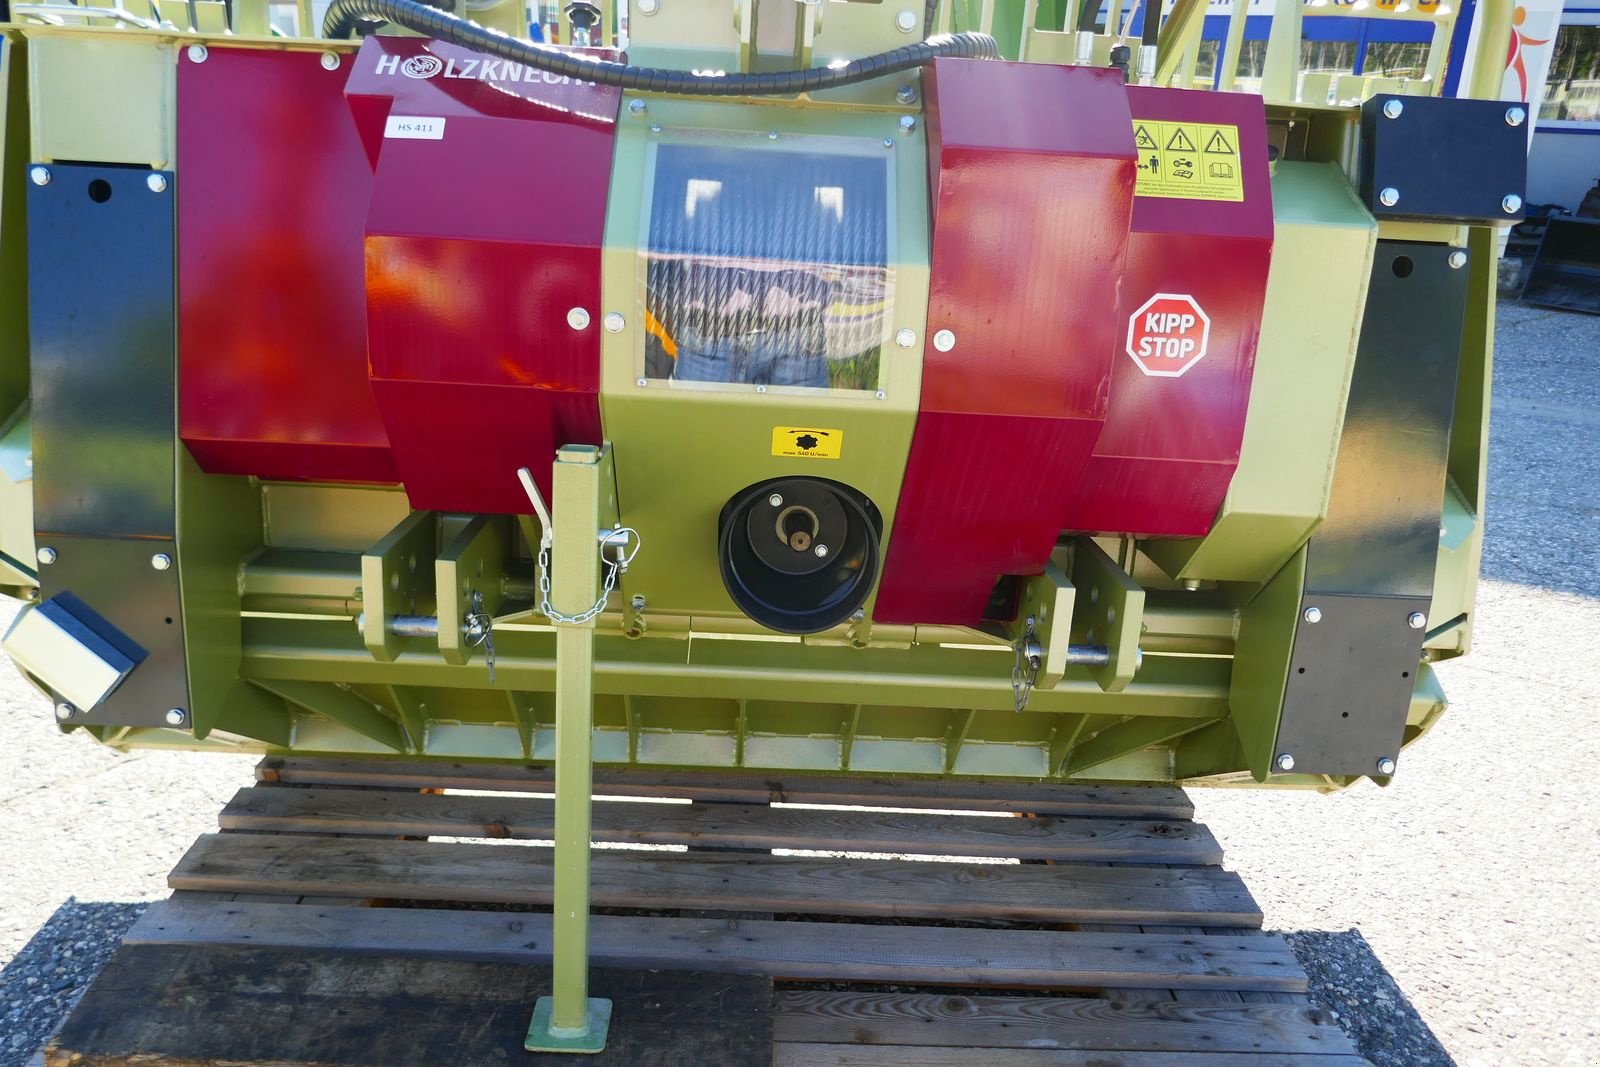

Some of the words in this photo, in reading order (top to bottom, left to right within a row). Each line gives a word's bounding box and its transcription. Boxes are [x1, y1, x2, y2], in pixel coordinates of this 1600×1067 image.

[414, 124, 433, 132] 411
[1145, 312, 1195, 334] KIPP
[1138, 336, 1195, 358] STOP
